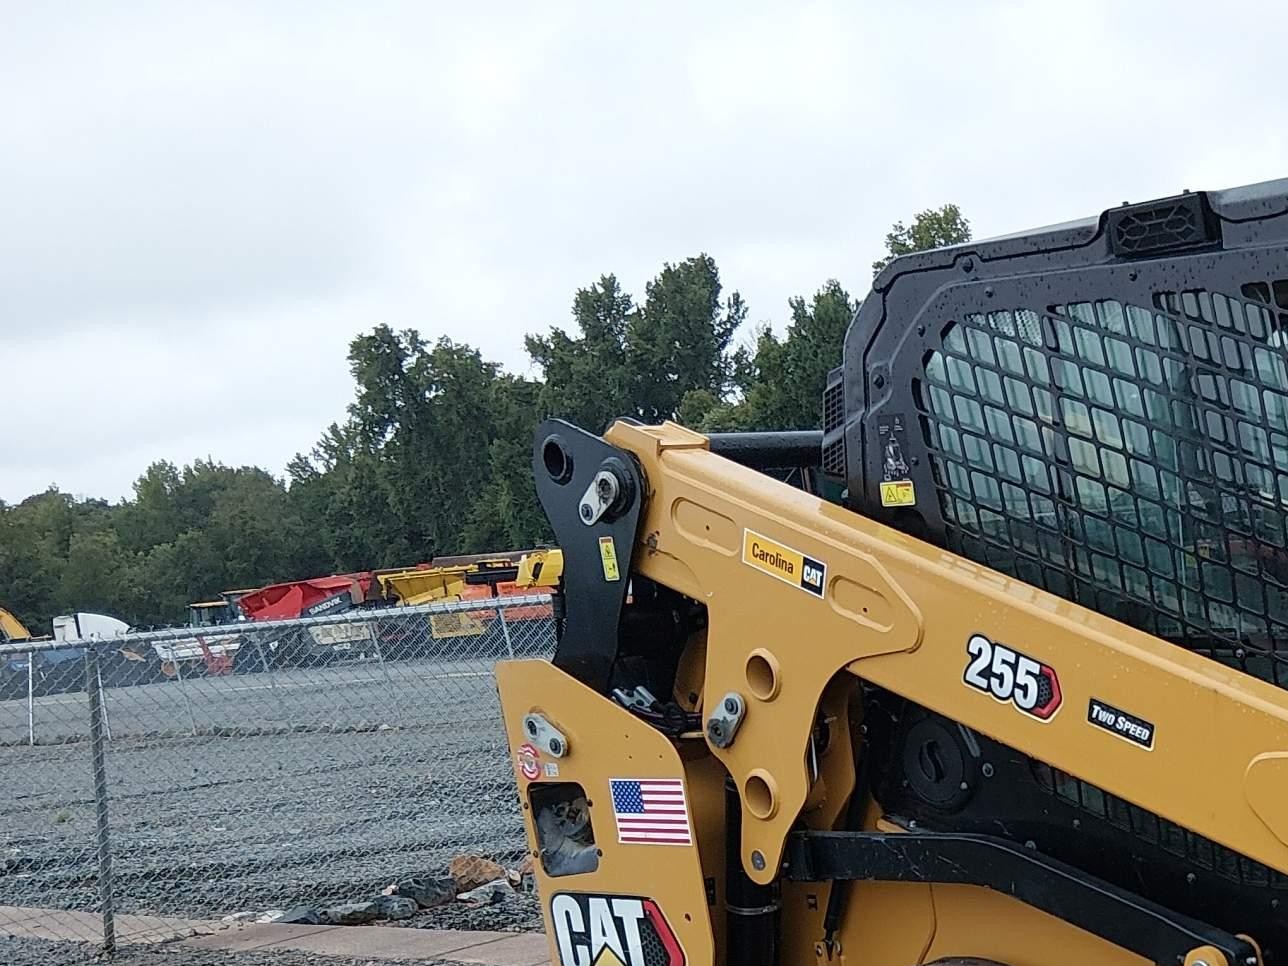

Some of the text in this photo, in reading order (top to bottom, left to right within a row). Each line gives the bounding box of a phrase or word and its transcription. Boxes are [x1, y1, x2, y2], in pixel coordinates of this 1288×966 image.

[752, 543, 823, 587] Carolina CAT
[965, 636, 1039, 709] 255
